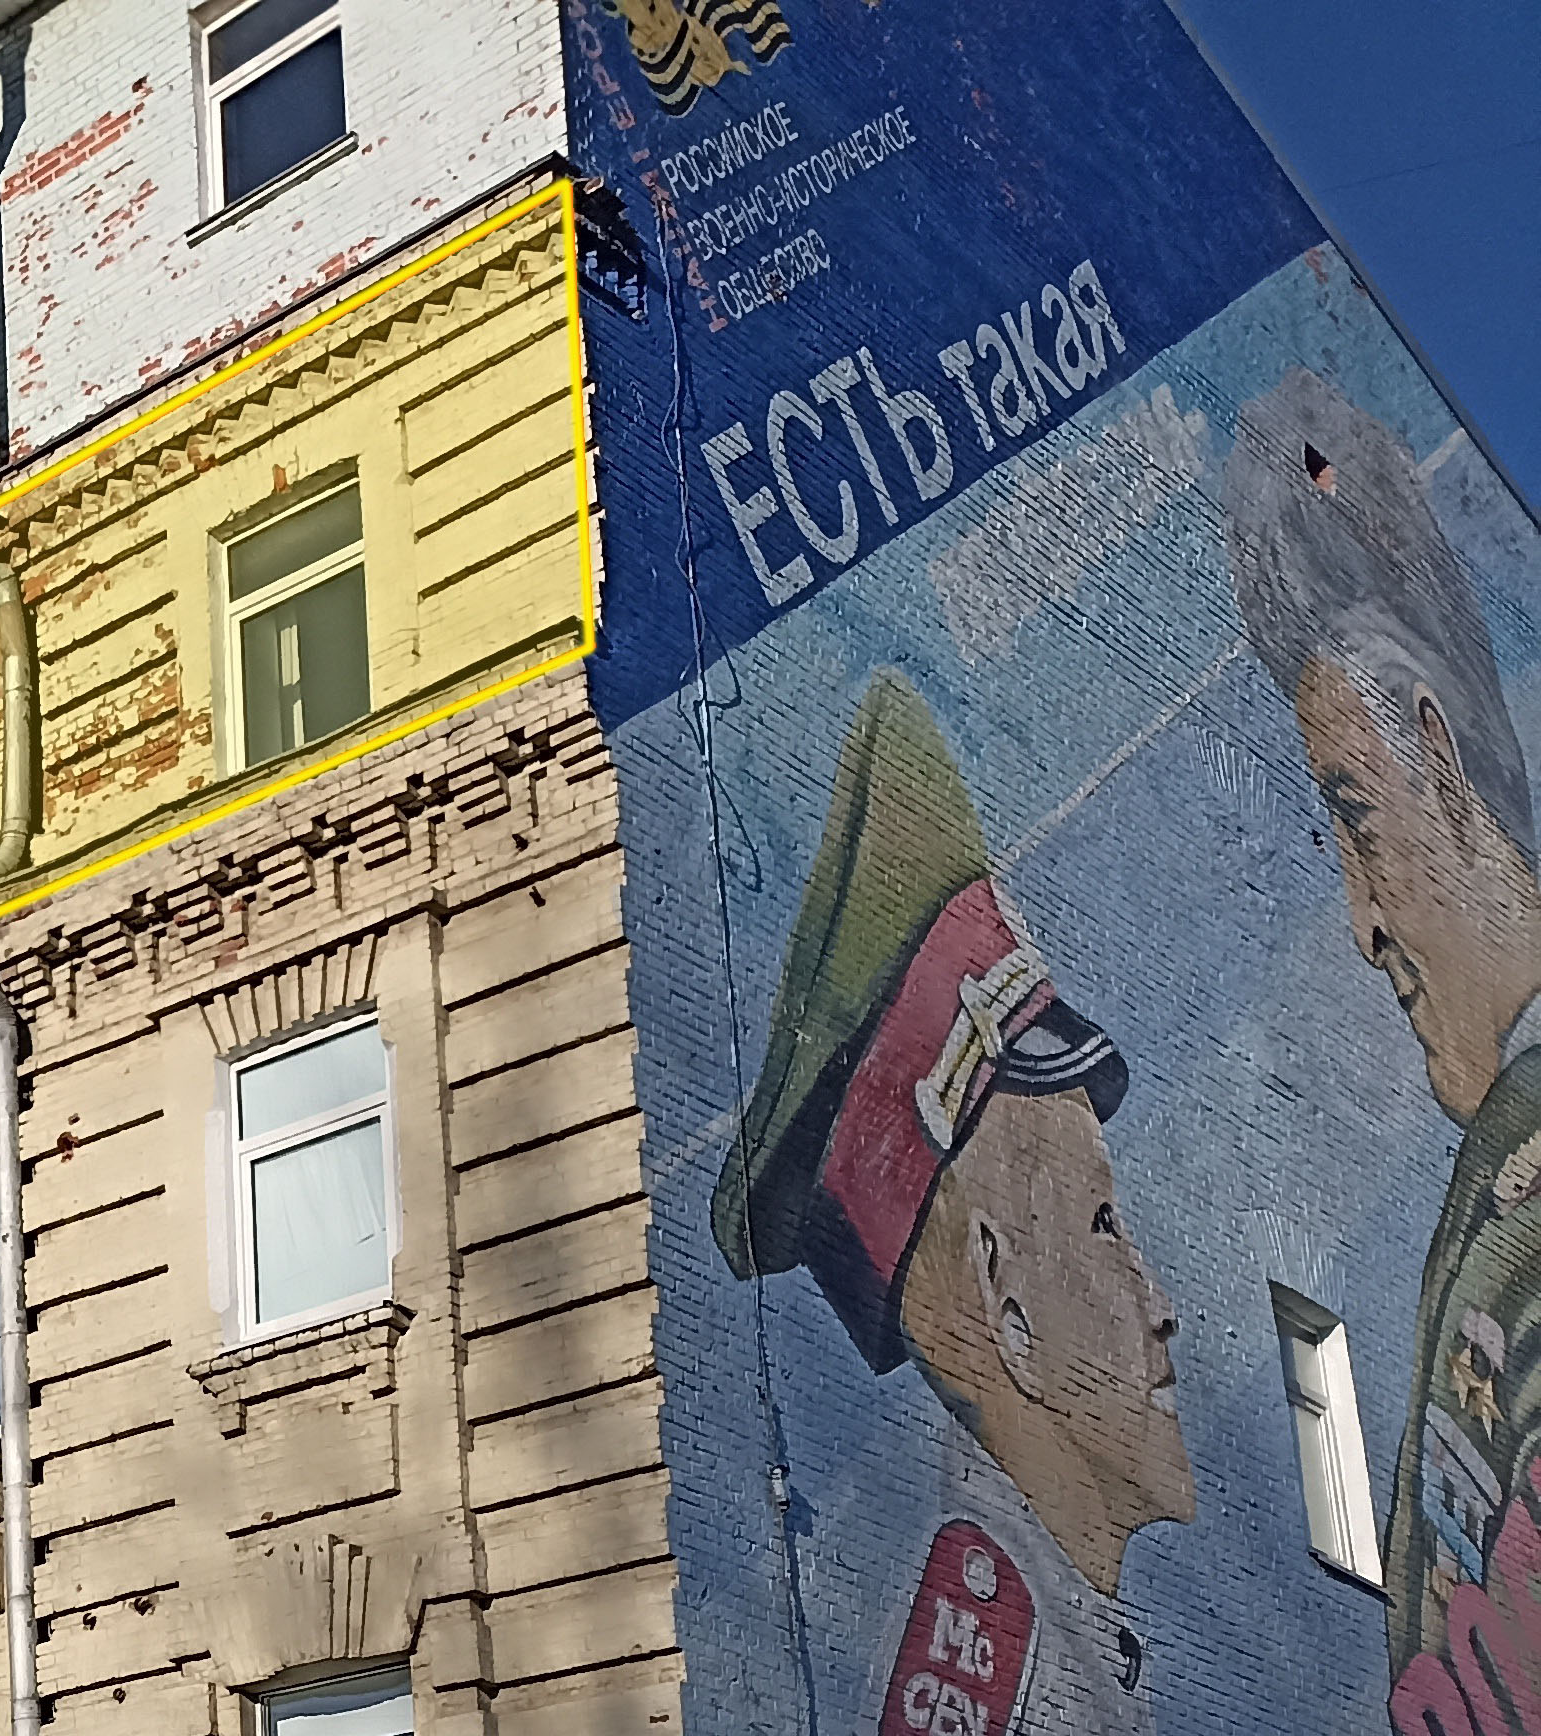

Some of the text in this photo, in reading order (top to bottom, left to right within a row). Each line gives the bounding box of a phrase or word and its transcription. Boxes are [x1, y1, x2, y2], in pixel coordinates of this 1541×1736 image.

[660, 100, 799, 199] РОССИЙСКОЕ
[686, 104, 917, 262] ВОЕННО-ИСТОРИЧЕСКОЕ
[700, 346, 954, 607] ЕСТЬ
